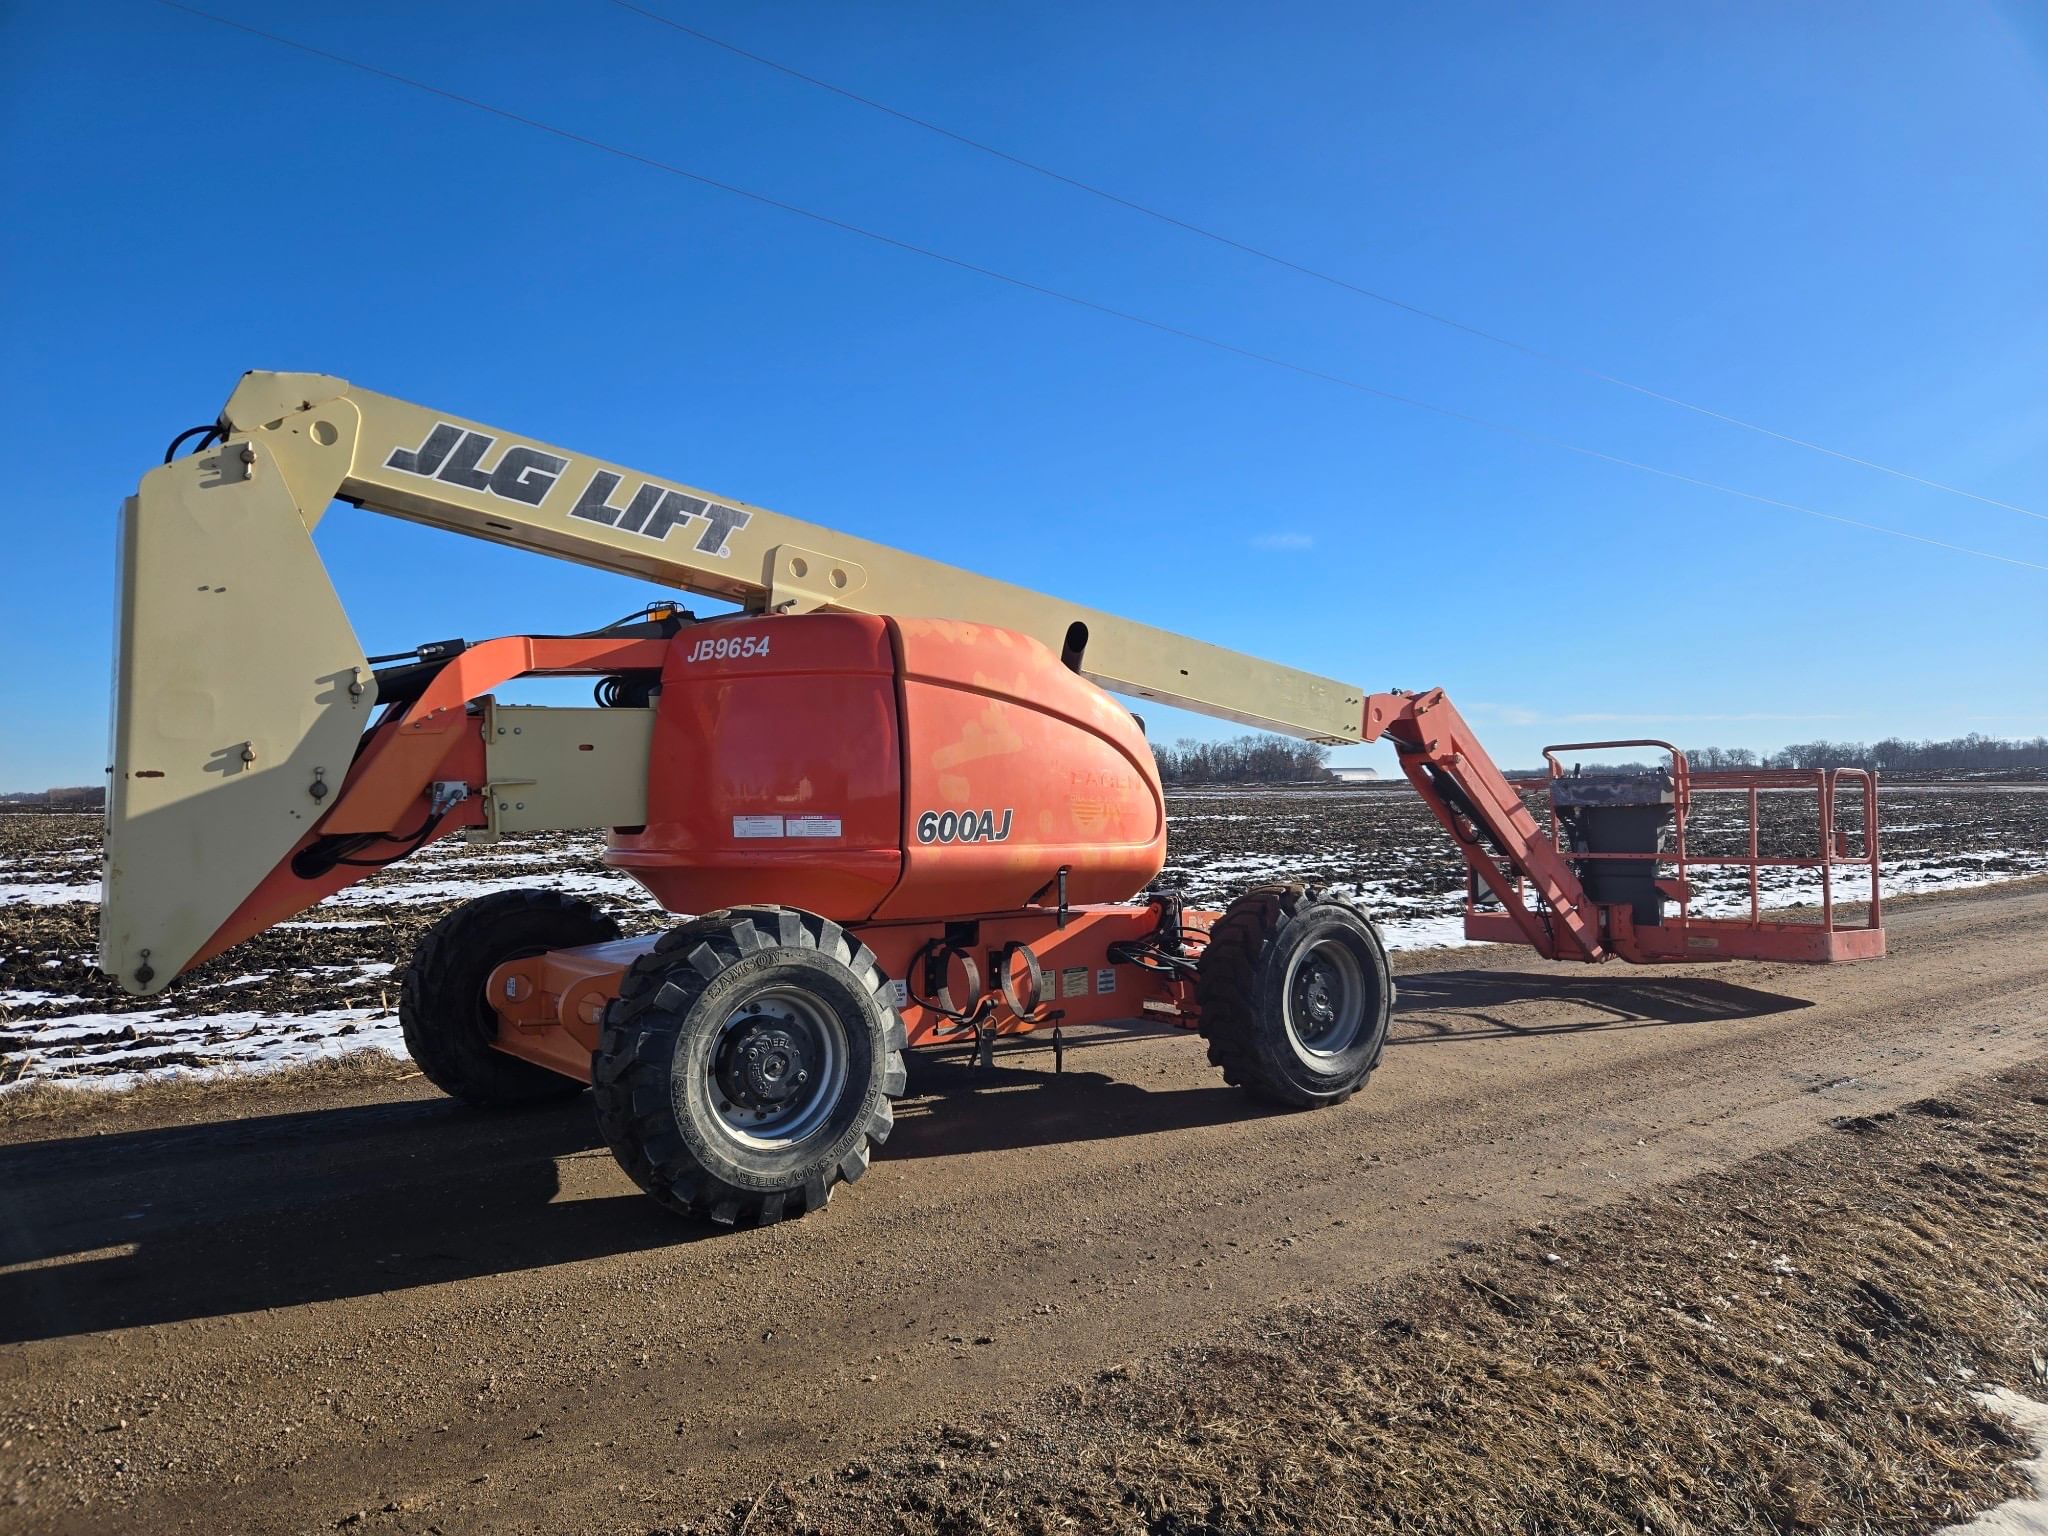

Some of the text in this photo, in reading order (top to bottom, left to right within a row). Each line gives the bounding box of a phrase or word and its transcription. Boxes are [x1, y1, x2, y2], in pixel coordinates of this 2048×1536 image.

[382, 421, 753, 555] JLG LIFT
[687, 635, 770, 663] JB9654
[916, 808, 1014, 844] 600AJ
[707, 950, 780, 1000] SAMSON
[738, 1172, 787, 1188] STEER
